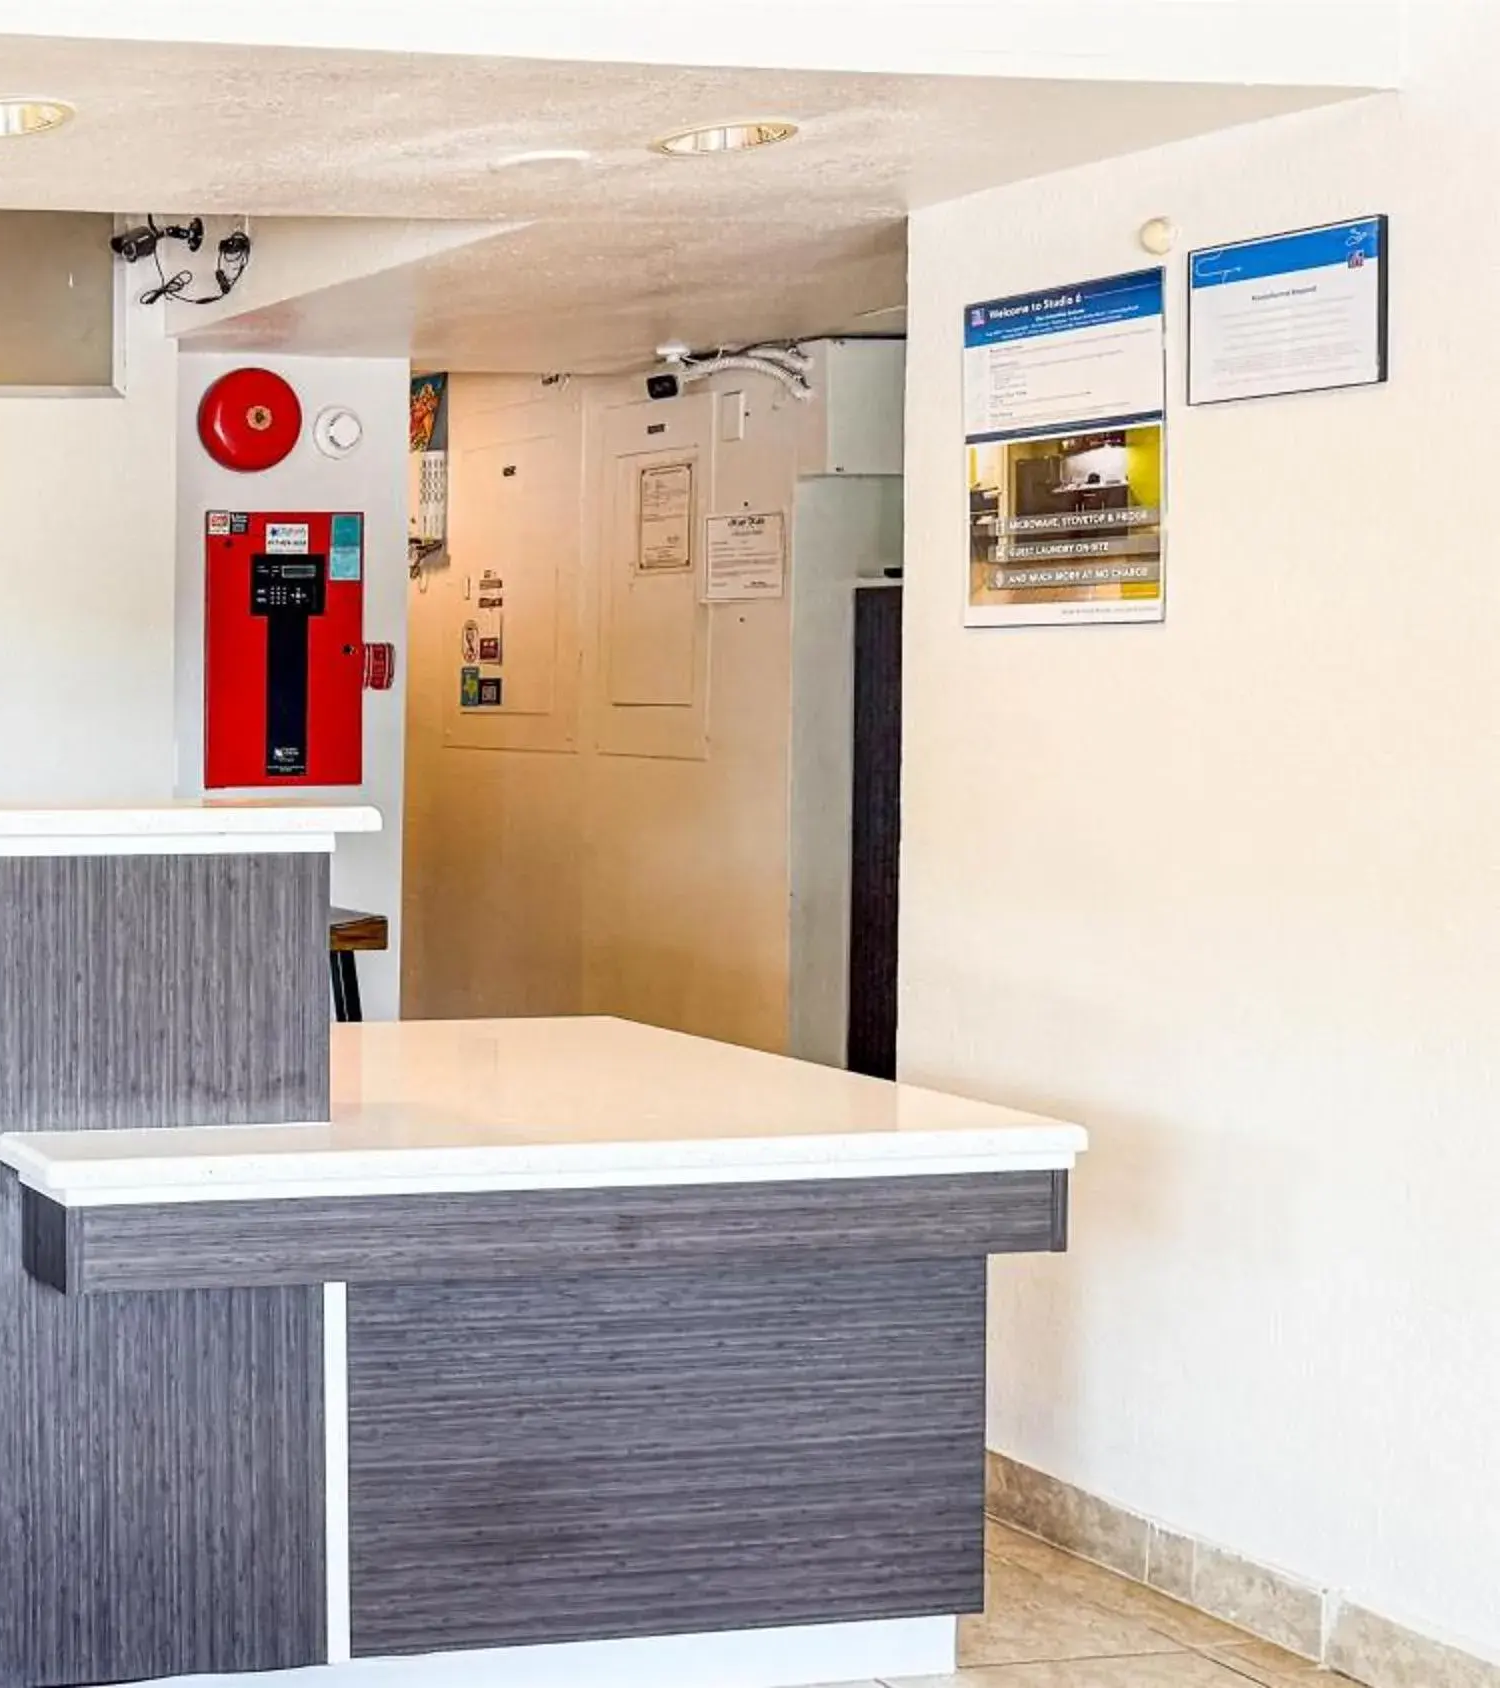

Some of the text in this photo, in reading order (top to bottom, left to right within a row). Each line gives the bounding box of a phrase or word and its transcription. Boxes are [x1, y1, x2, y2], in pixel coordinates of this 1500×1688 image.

[988, 304, 1030, 320] Welcome
[1031, 302, 1042, 312] to
[1043, 295, 1074, 310] Studio
